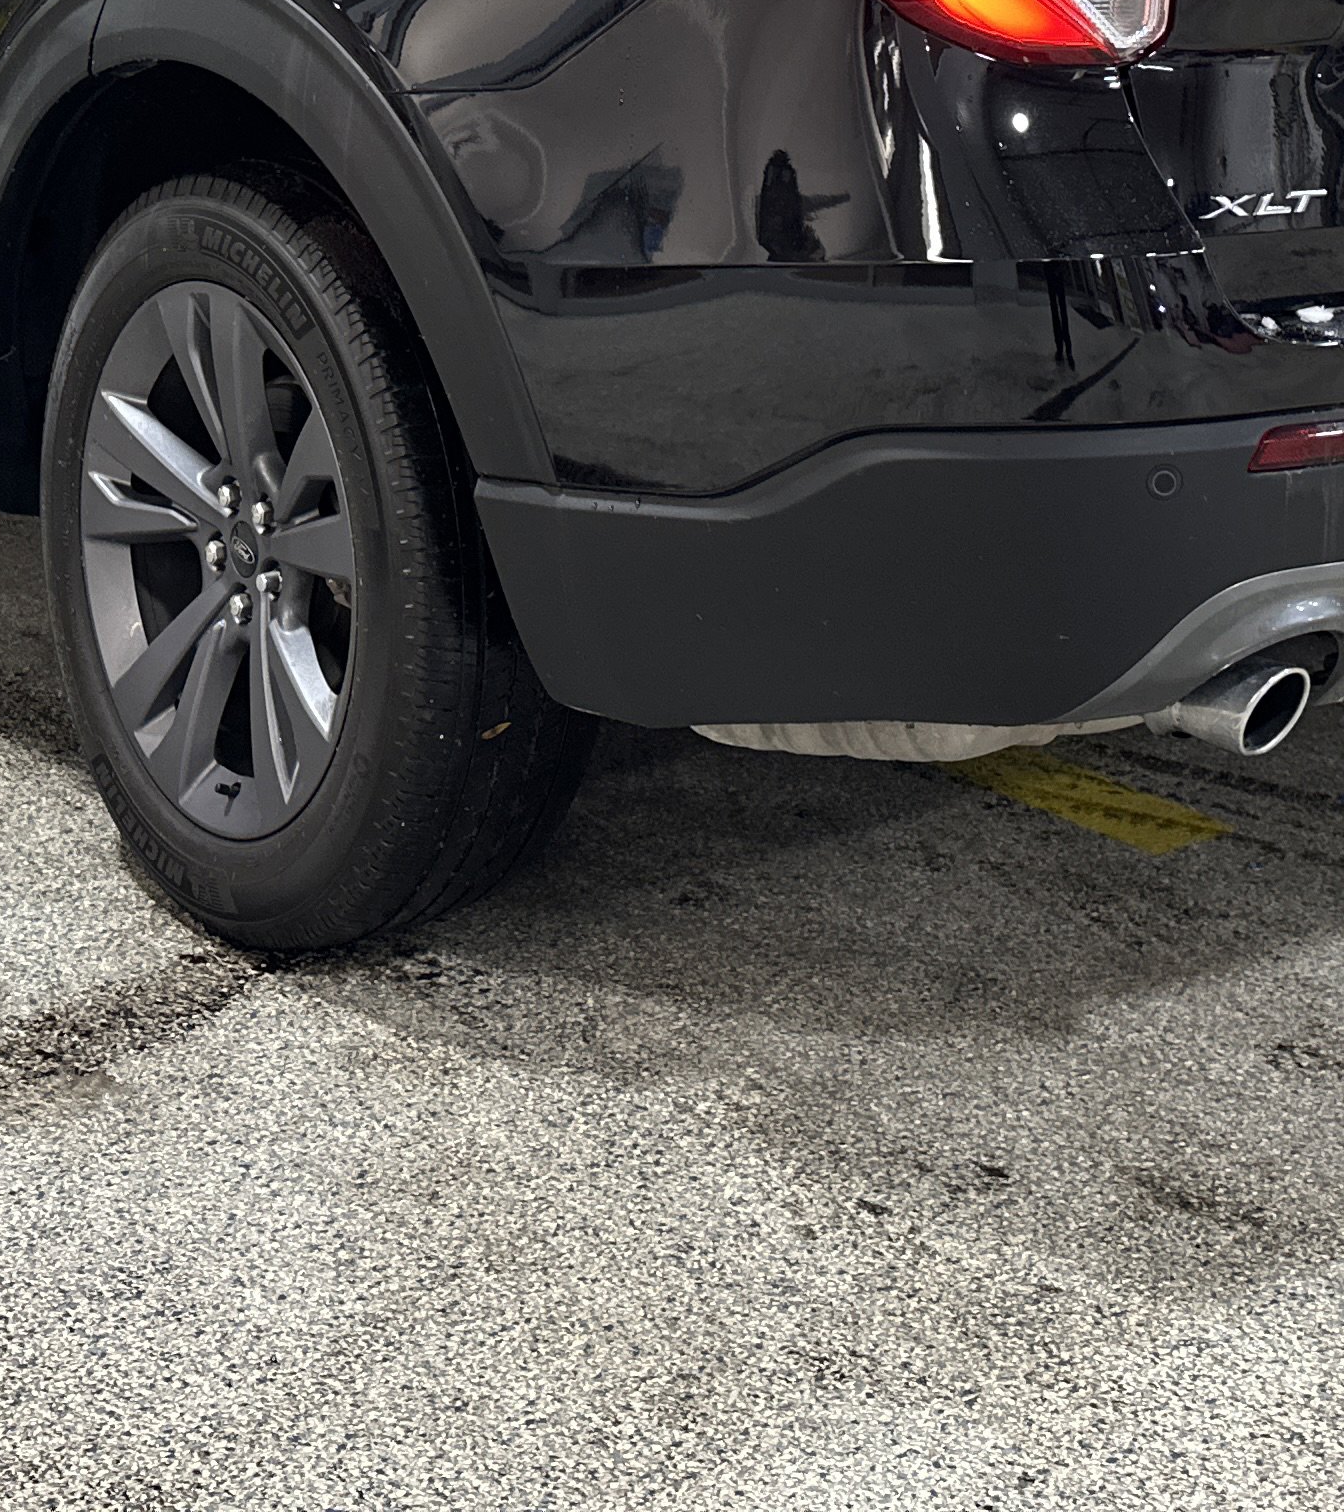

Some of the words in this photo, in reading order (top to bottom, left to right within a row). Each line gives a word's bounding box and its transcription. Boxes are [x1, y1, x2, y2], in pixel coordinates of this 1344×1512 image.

[1198, 188, 1328, 219] XLT
[201, 225, 310, 332] MICHELIN
[315, 351, 363, 462] PRIMACY
